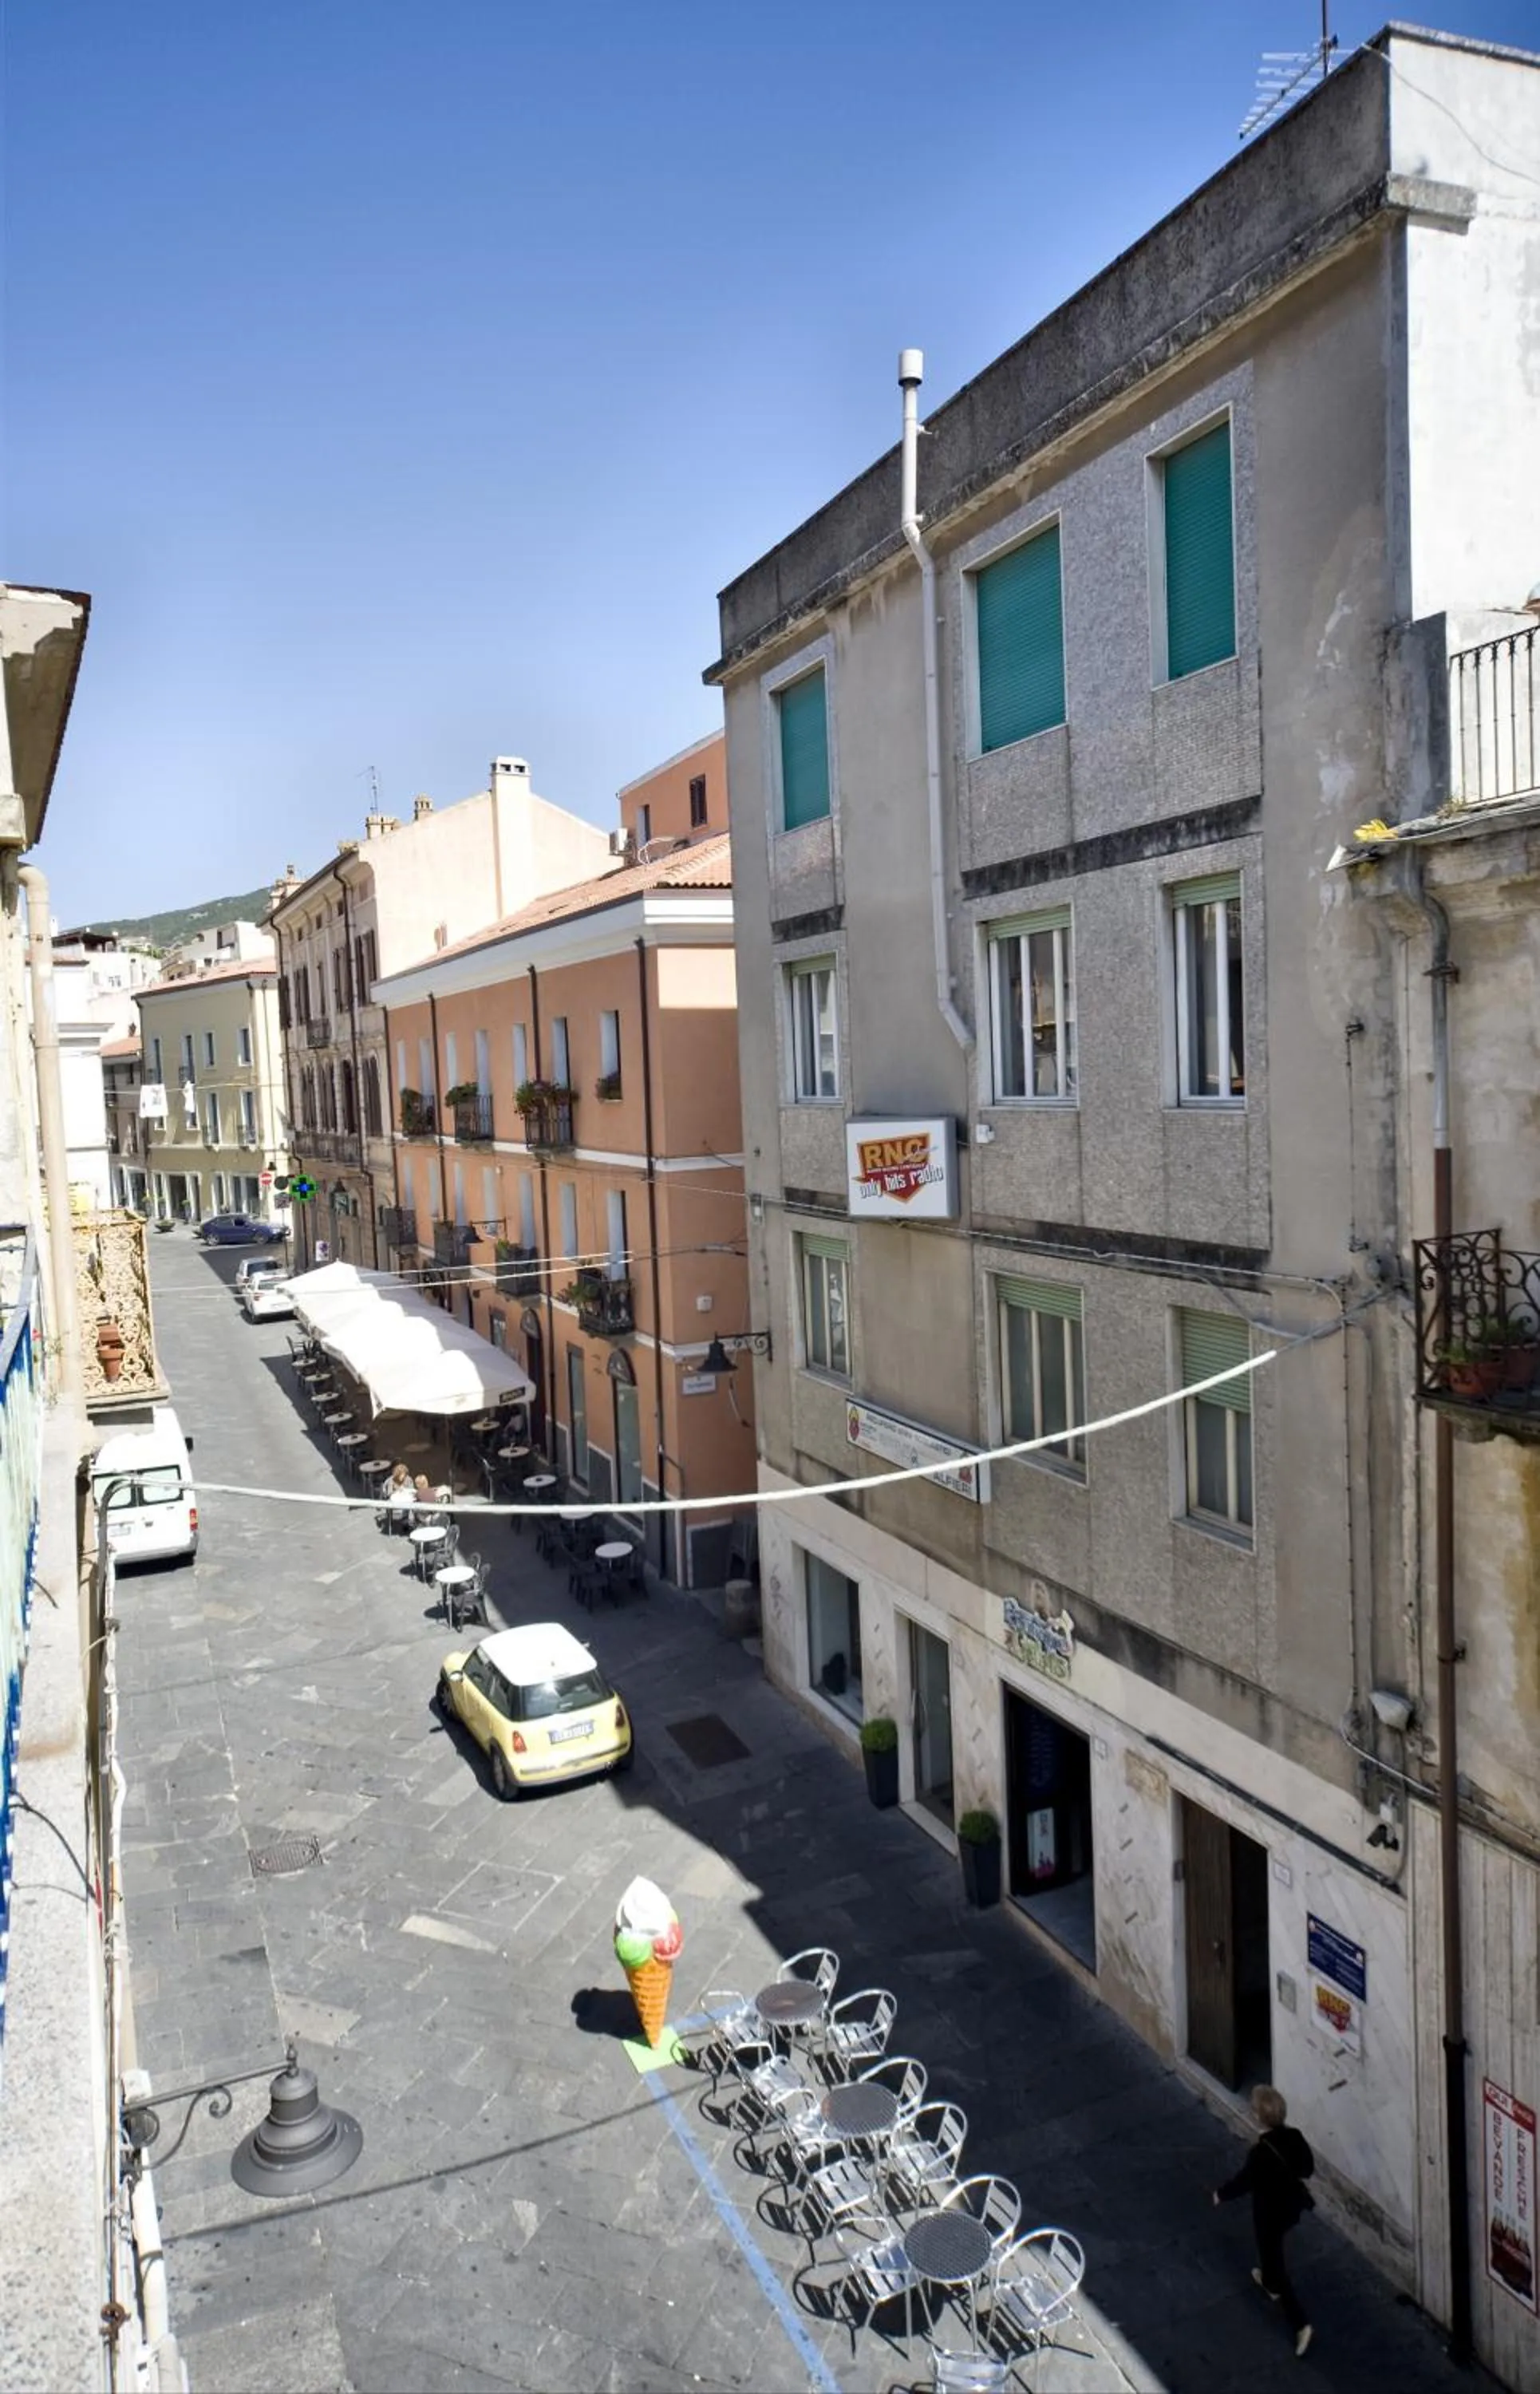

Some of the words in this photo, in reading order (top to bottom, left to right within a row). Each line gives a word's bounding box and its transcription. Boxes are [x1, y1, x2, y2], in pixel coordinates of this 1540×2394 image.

[860, 1177, 883, 1199] only
[884, 1173, 906, 1191] hits
[909, 1163, 944, 1186] radio
